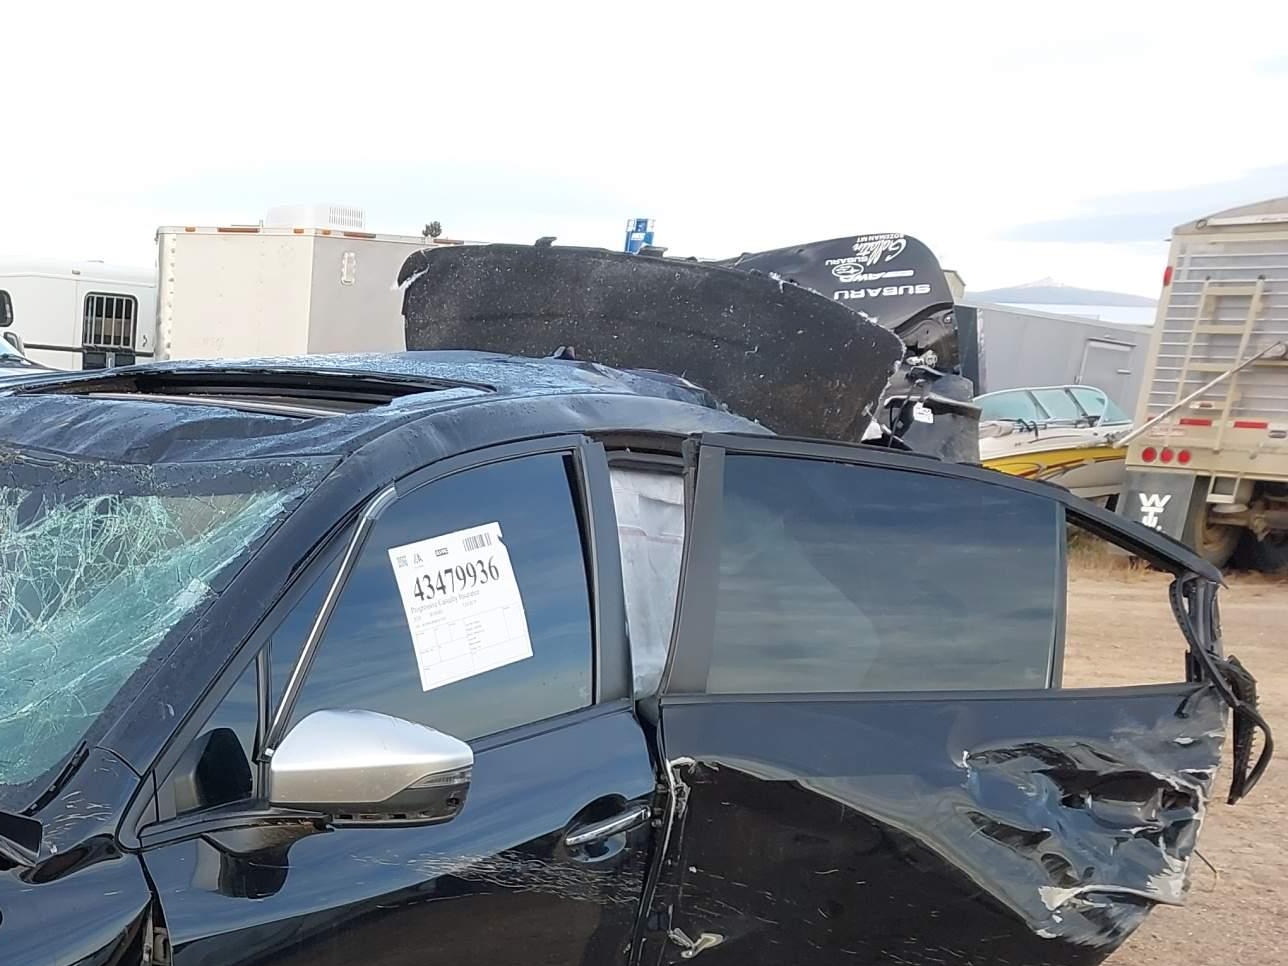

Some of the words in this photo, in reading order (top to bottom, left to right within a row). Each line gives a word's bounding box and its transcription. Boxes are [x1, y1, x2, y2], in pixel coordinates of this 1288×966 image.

[852, 238, 907, 266] Gallatin
[825, 256, 868, 266] SUBARU
[839, 271, 886, 283] AWD
[834, 284, 930, 300] SUBARU
[414, 555, 500, 601] 43479936
